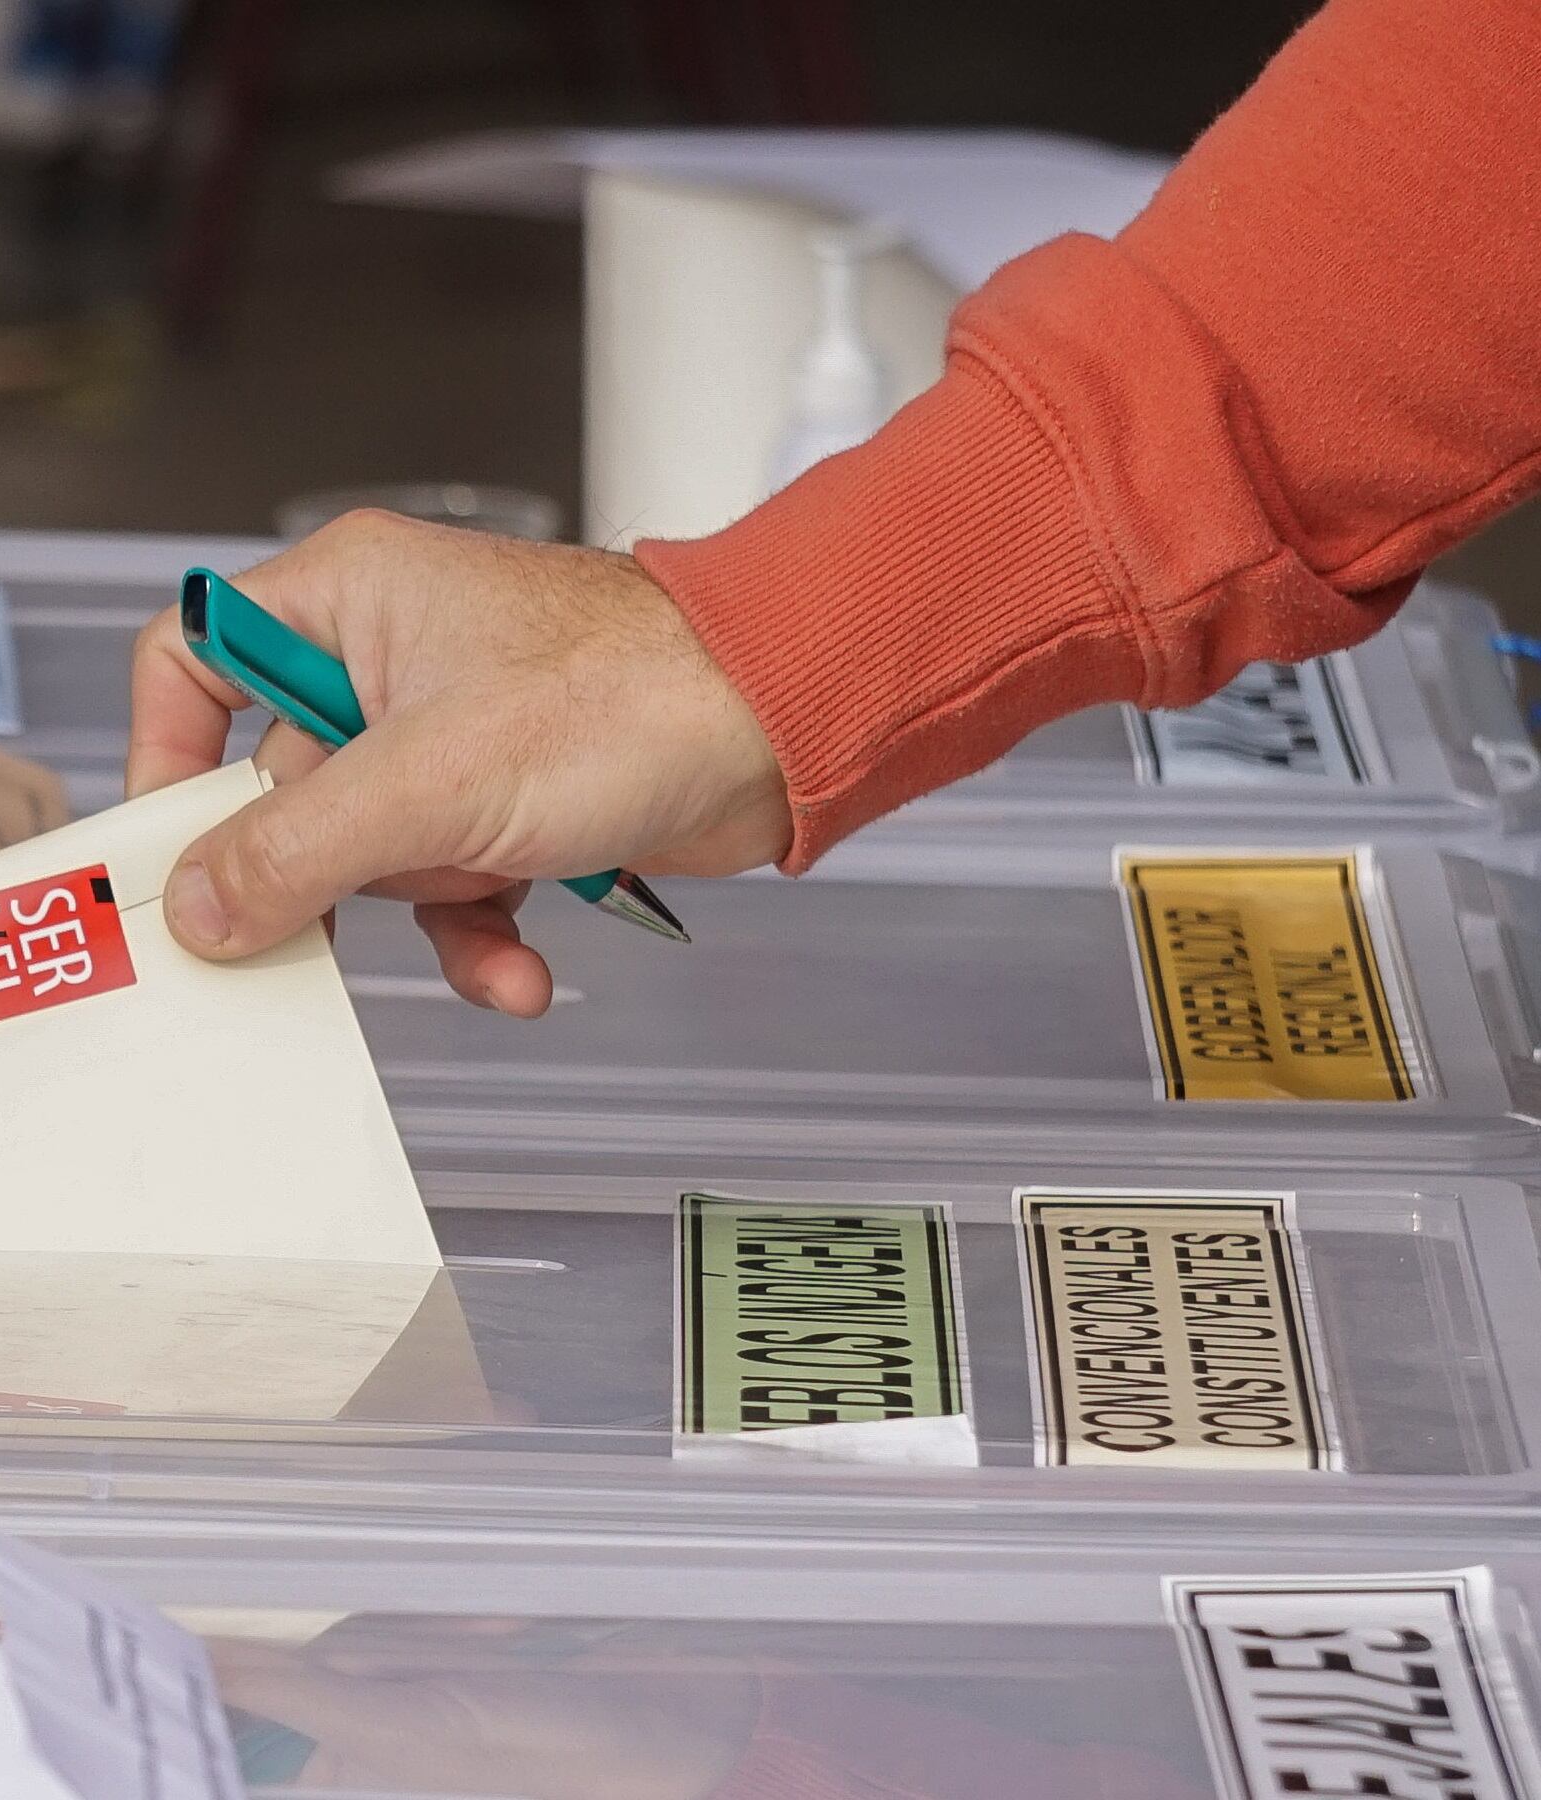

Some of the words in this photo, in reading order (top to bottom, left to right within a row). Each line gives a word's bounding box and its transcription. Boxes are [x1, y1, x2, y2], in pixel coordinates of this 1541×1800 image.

[10, 887, 93, 997] SER
[1165, 905, 1274, 1064] GOBERNADOR
[1269, 943, 1374, 1058] REGIONAL
[736, 1329, 914, 1431] EBLOS
[1058, 1225, 1177, 1452] CONVENCIONALES
[1171, 1231, 1297, 1449] CONSTITUYENTES
